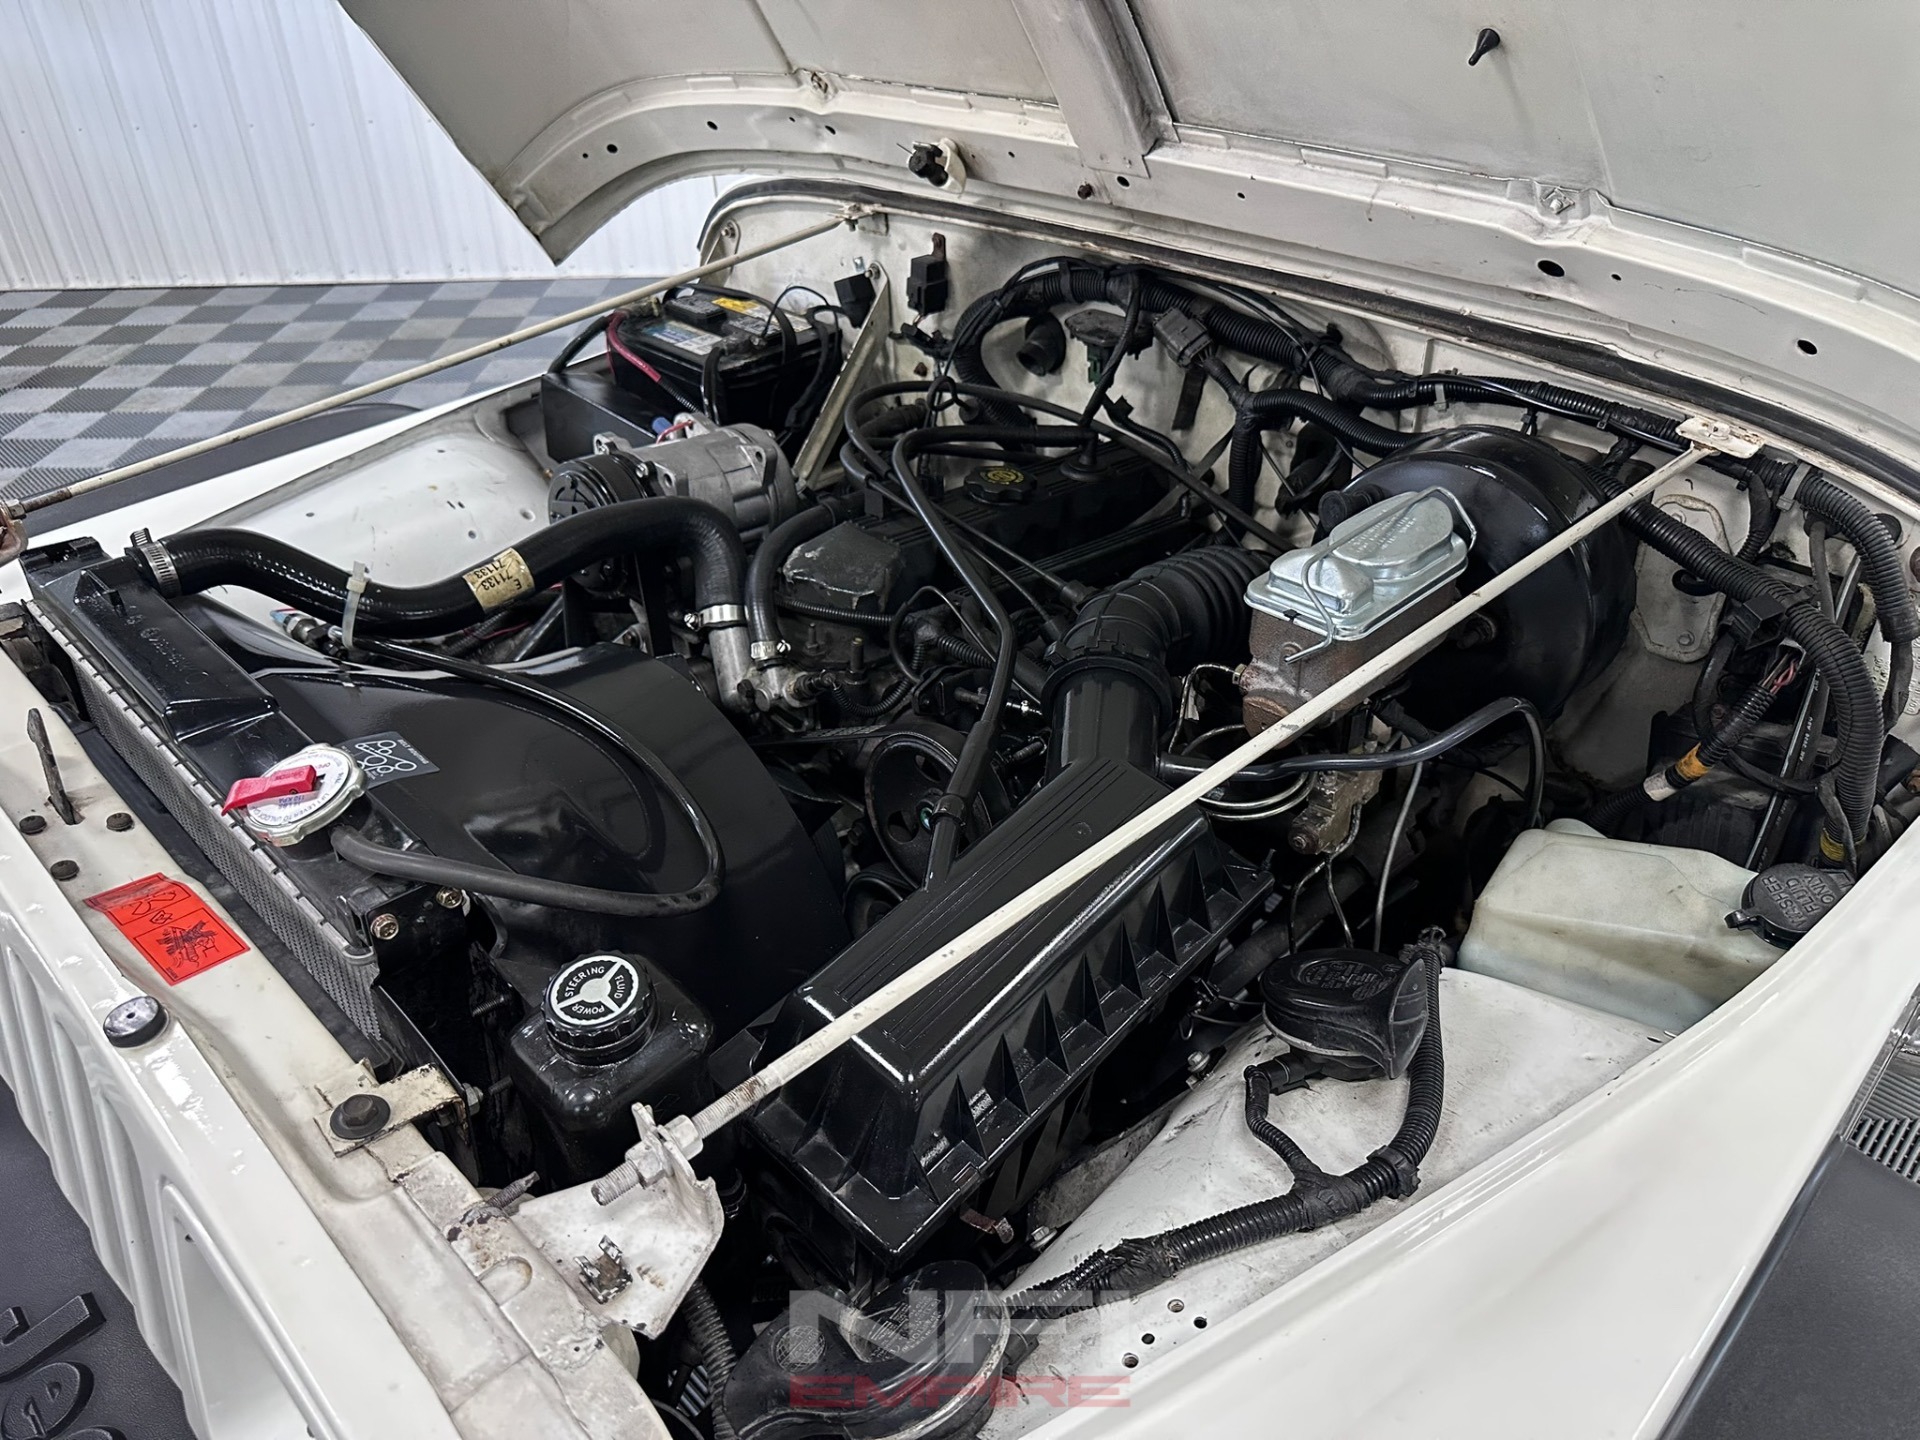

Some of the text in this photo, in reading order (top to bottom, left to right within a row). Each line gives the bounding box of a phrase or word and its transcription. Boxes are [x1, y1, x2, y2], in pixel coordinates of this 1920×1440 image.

[473, 559, 506, 579] 71133
[480, 569, 514, 591] 71133
[1786, 877, 1820, 914] FLUID
[1804, 873, 1836, 905] ONLY
[564, 966, 626, 1015] POWER STEERING FLUID
